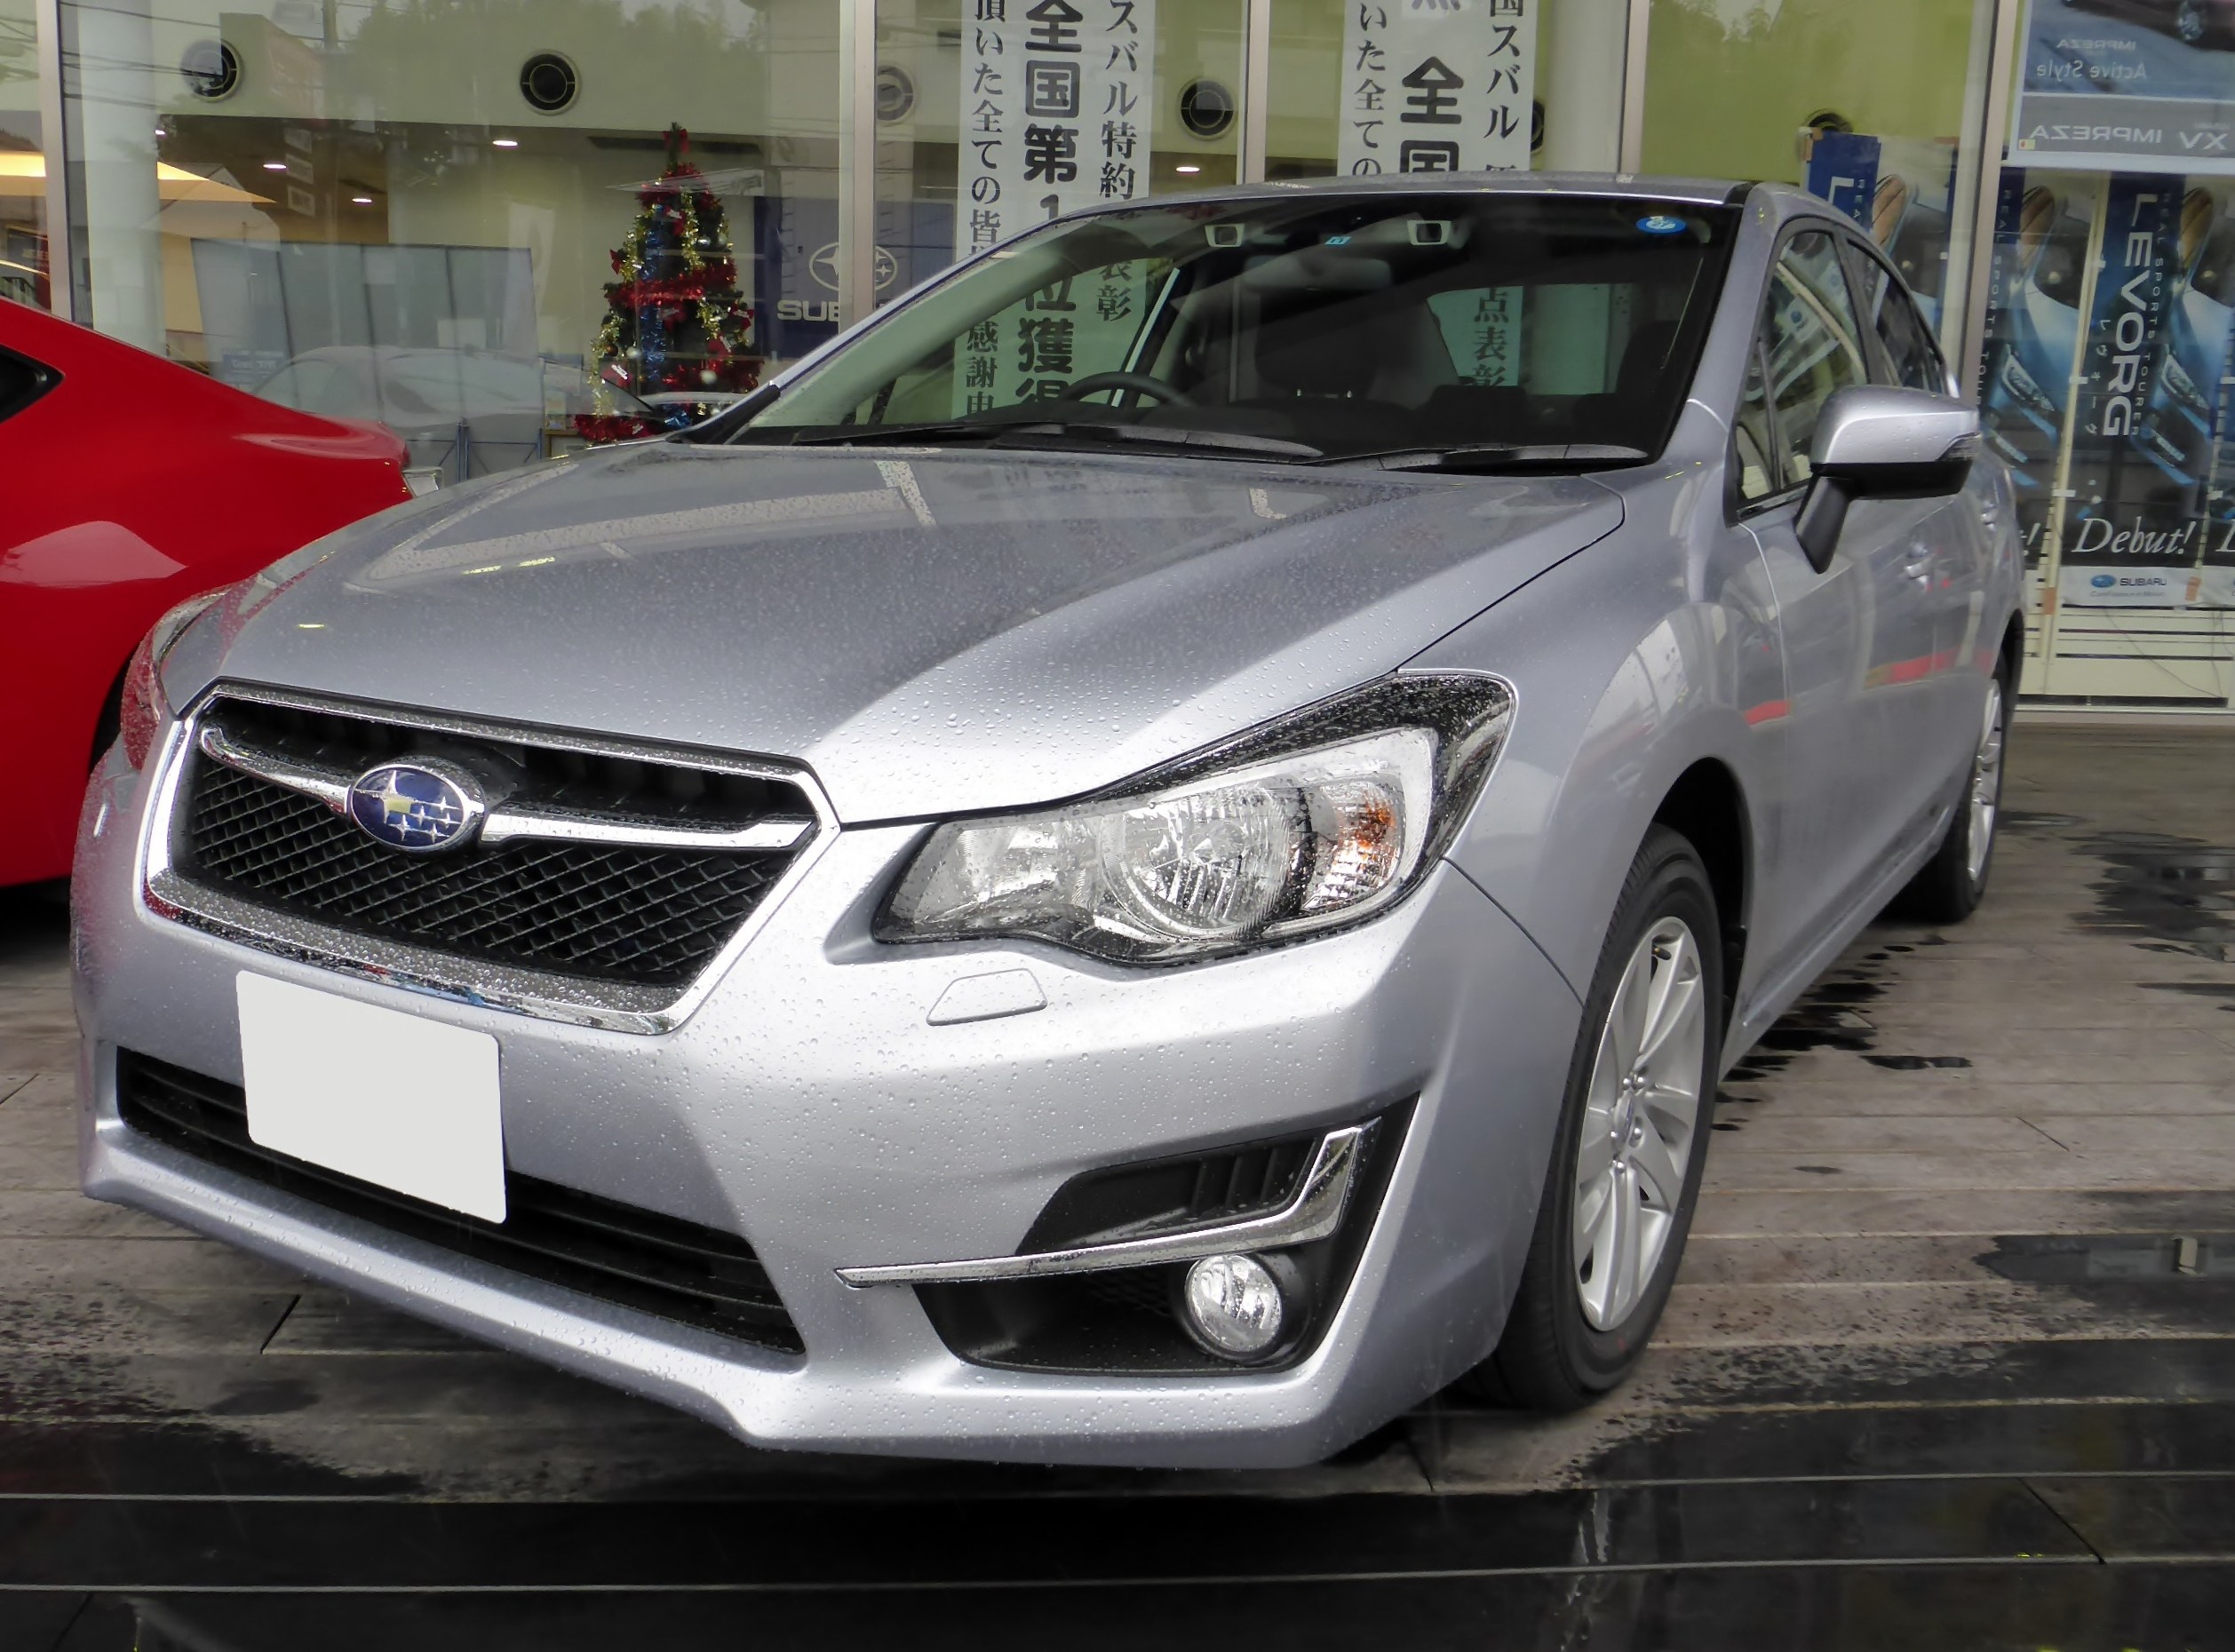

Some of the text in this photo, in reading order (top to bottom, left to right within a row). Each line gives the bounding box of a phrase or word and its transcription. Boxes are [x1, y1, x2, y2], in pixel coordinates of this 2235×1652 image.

[1984, 255, 2003, 338] SPORTS
[2102, 193, 2159, 437] LEVORG
[2146, 257, 2165, 339] SPORTS
[2071, 516, 2197, 555] Debut!
[2120, 577, 2167, 586] SUBARU
